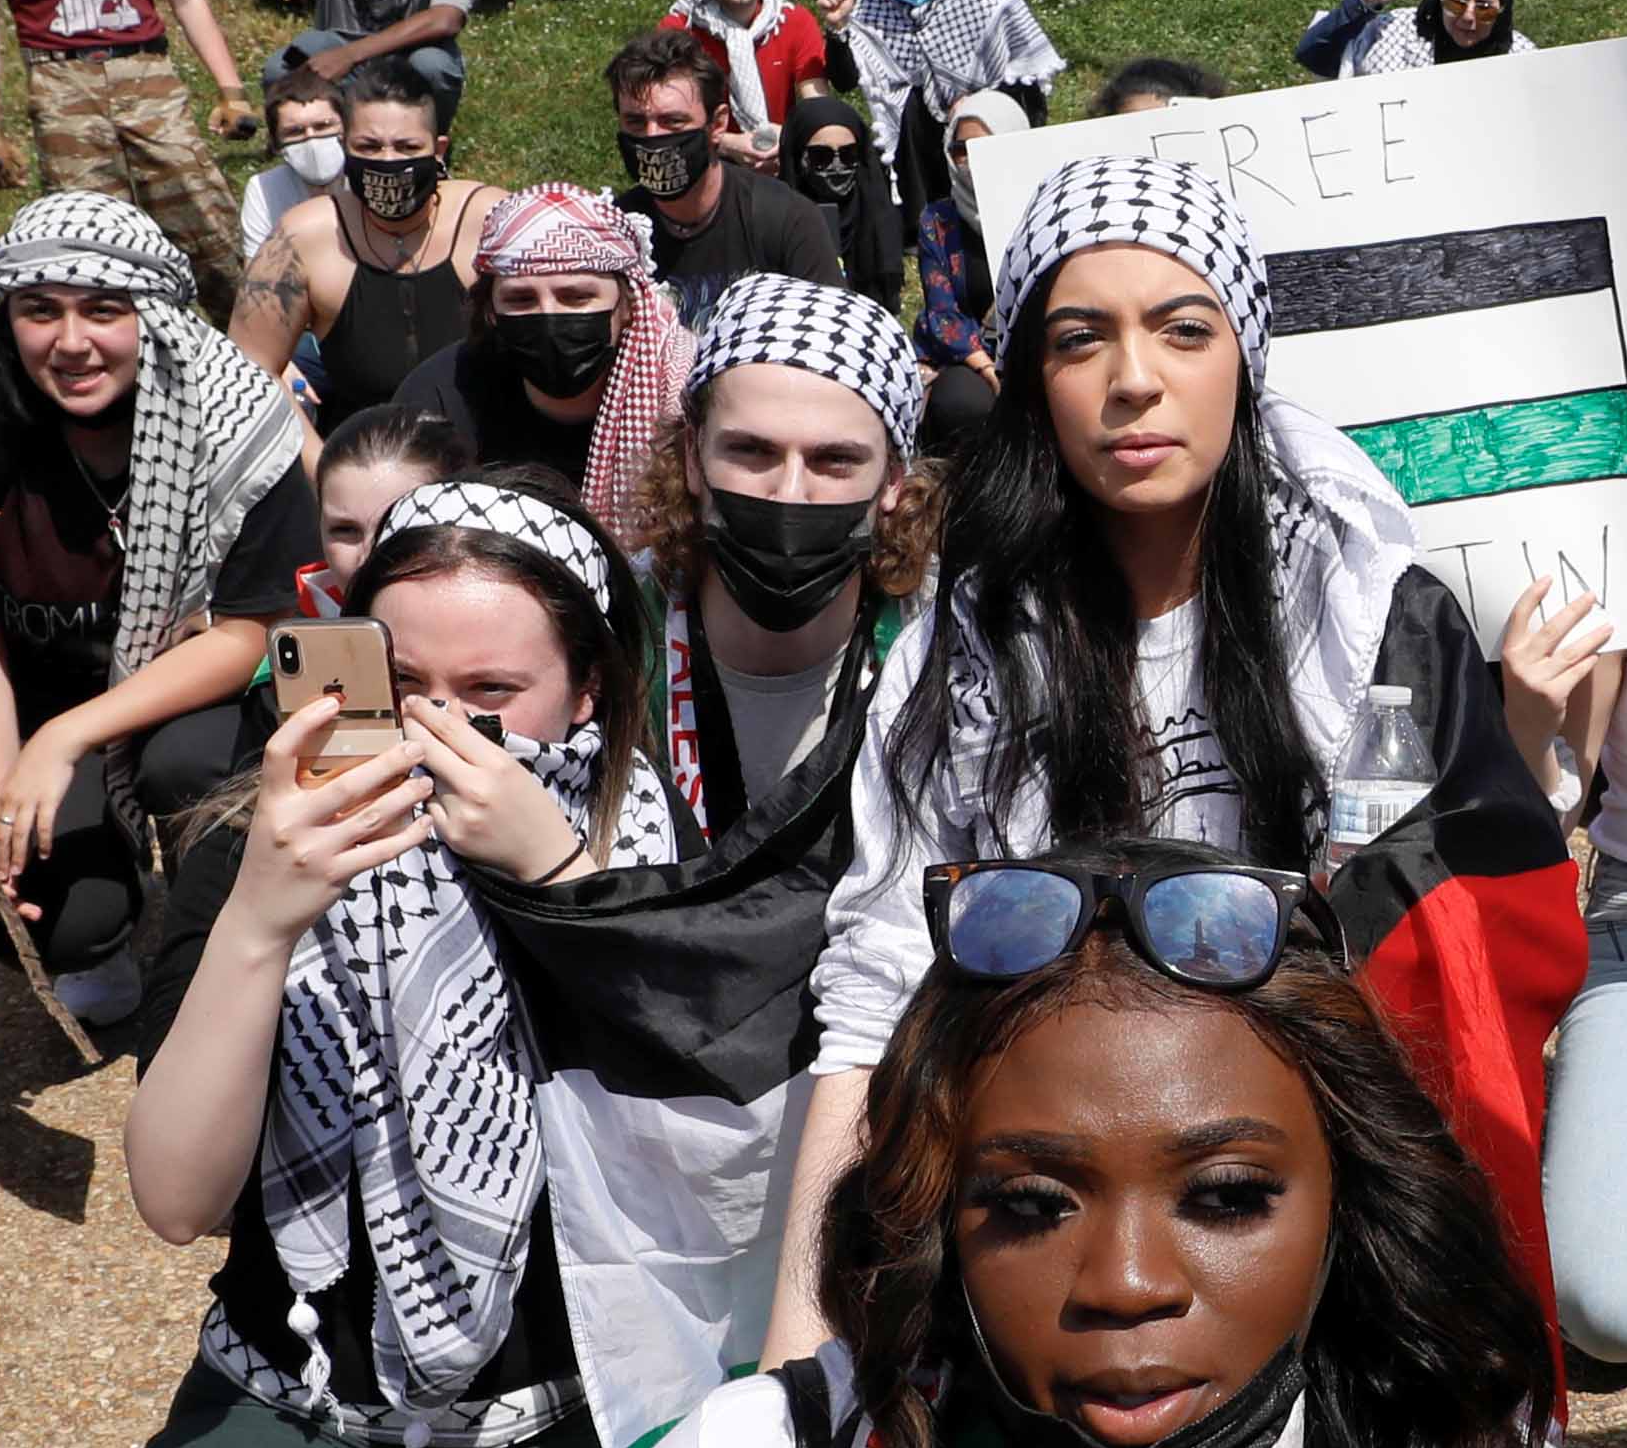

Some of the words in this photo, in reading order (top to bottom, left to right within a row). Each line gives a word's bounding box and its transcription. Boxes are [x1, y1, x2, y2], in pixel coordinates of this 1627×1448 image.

[636, 148, 681, 166] BLACK
[638, 159, 687, 181] LIVES
[670, 637, 712, 839] ALES
